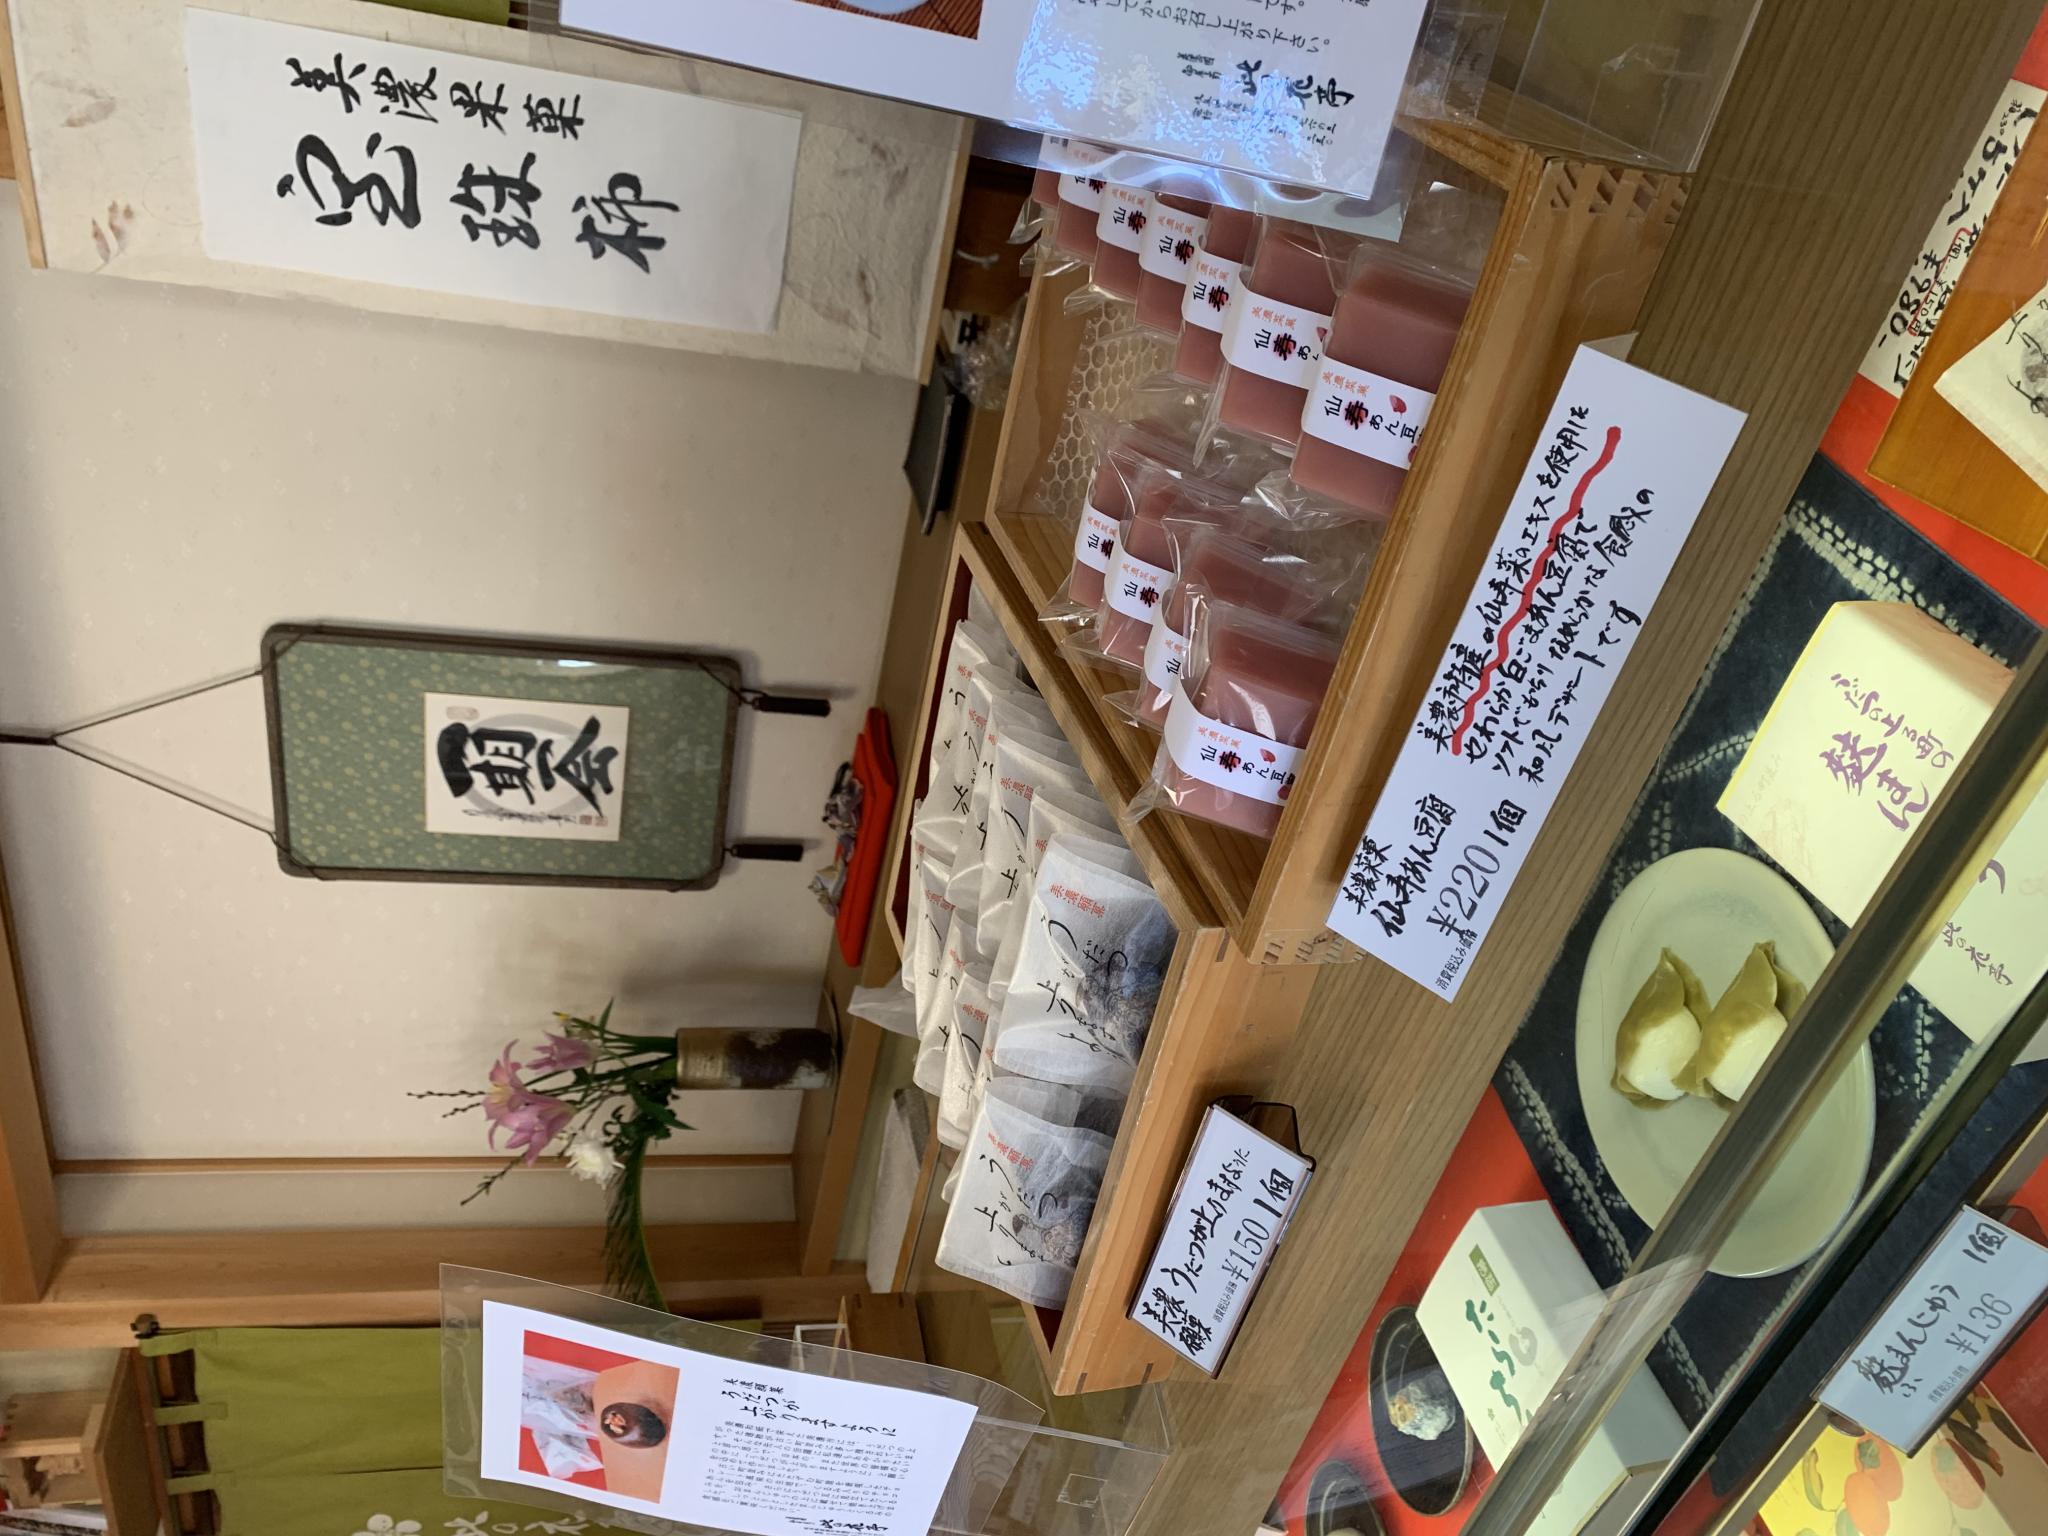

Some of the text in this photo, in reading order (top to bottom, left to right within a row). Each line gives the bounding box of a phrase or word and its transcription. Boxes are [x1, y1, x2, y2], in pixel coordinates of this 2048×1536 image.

[1323, 393, 1424, 444] 仙寿あん豆
[436, 714, 619, 818] 一期一会
[1370, 792, 1457, 938] 仙寿あん豆腐
[1425, 844, 1501, 936] ¥220
[1434, 928, 1478, 991] 消費税込み価格
[1944, 1292, 2013, 1356] ¥136
[721, 1389, 800, 1413] うだつが
